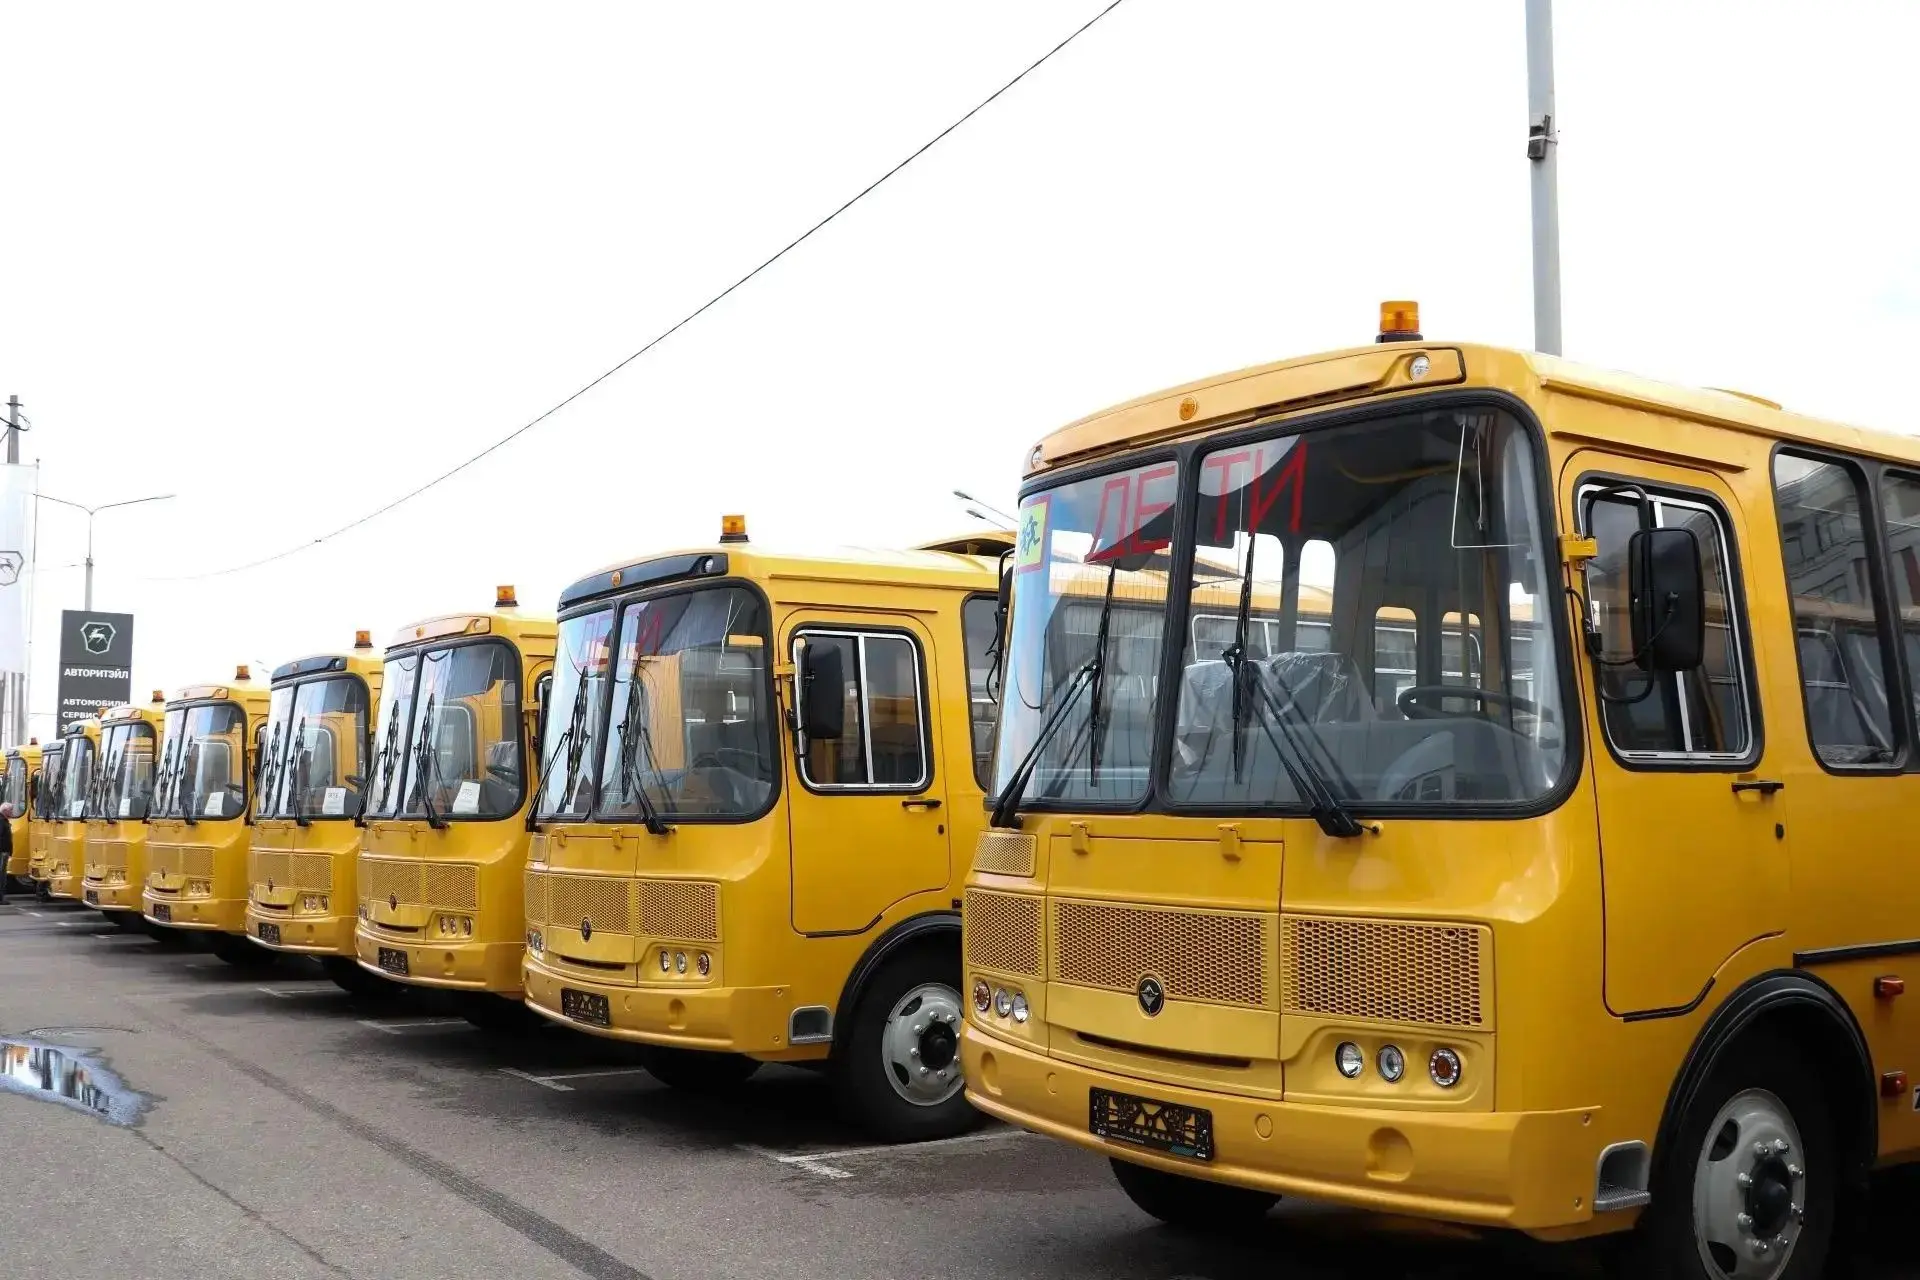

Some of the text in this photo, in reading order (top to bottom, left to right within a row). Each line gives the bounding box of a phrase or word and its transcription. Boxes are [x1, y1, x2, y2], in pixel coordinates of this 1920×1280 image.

[1084, 440, 1308, 563] ДЕТИ
[64, 668, 129, 678] АВТОРИТЭЙЛ
[63, 699, 128, 707] АВТОМОБИЛИ
